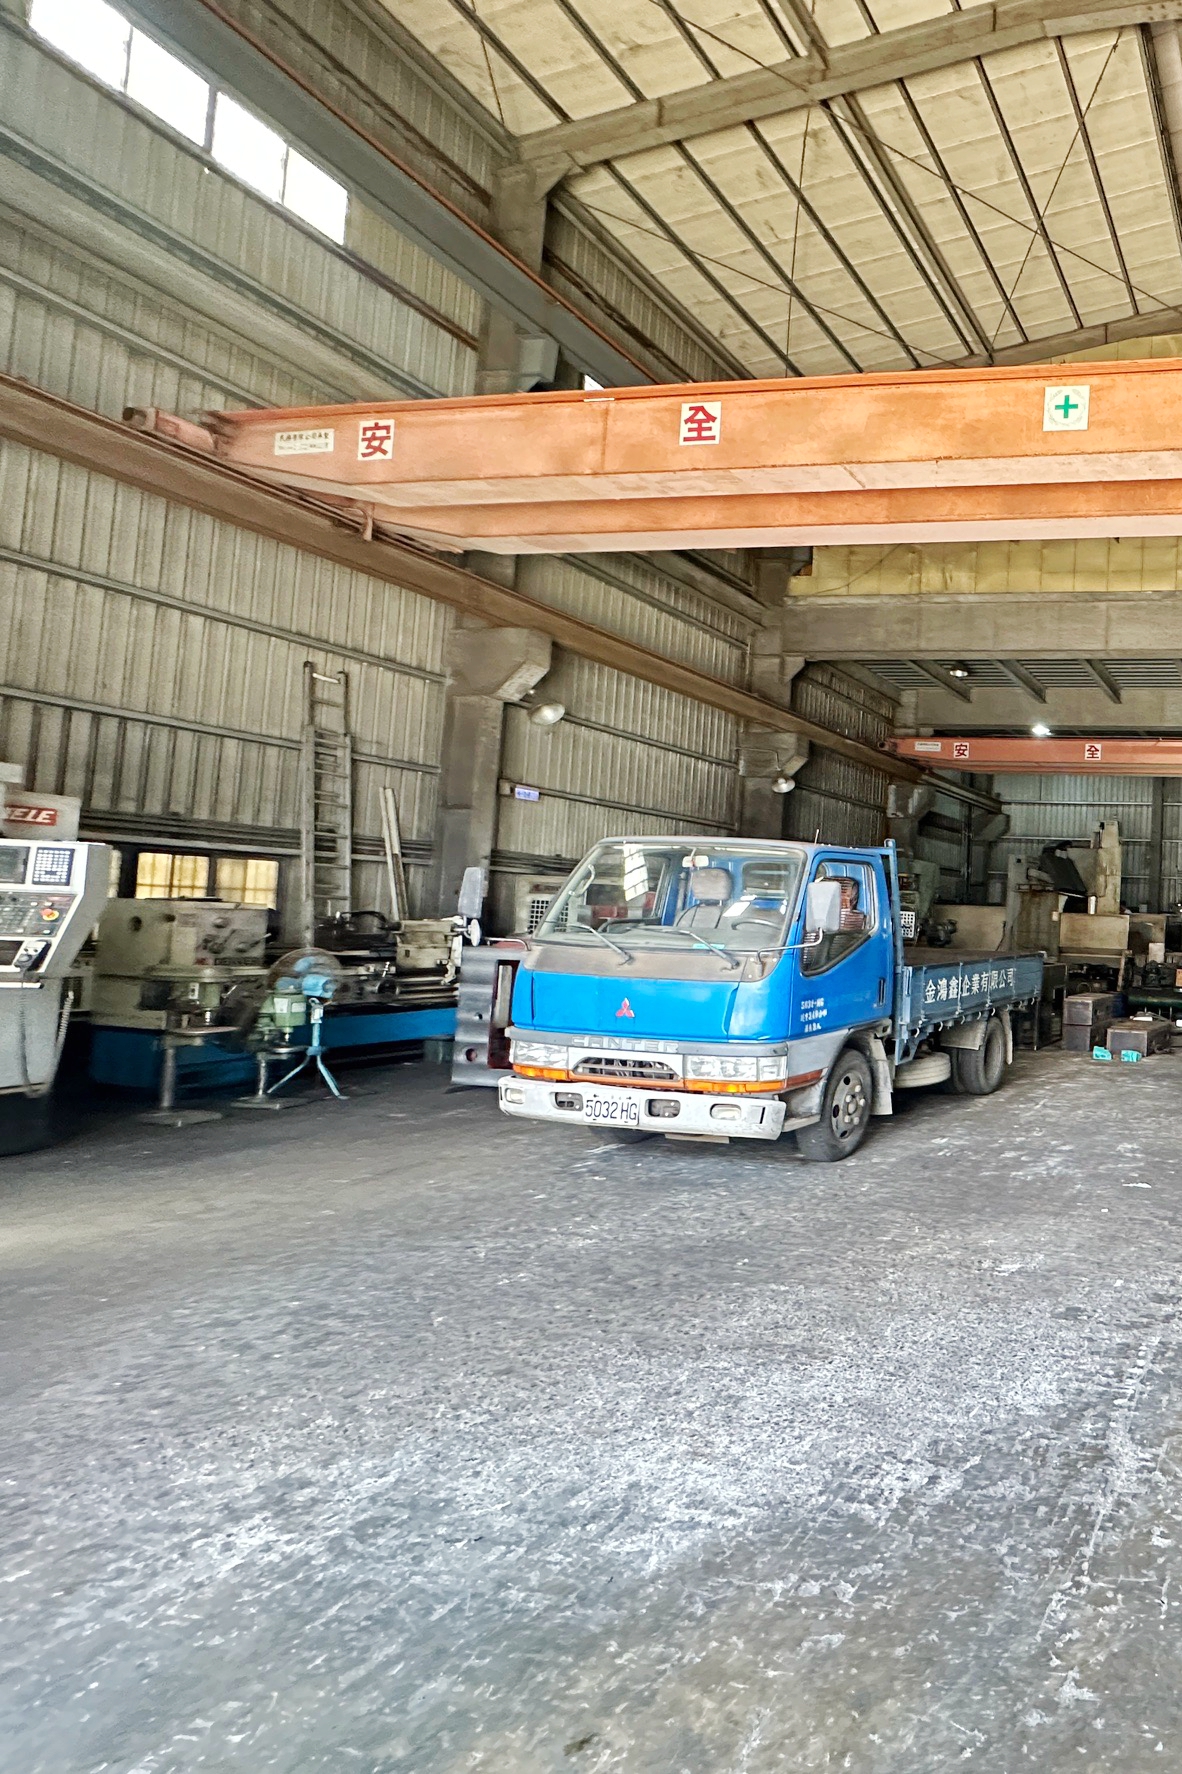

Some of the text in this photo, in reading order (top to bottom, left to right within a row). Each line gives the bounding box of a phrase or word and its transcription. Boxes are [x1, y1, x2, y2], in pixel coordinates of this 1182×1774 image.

[361, 422, 391, 458] 安
[683, 405, 717, 442] 全
[955, 743, 967, 757] 安
[1086, 745, 1100, 758] 全
[572, 1035, 679, 1053] CANTER
